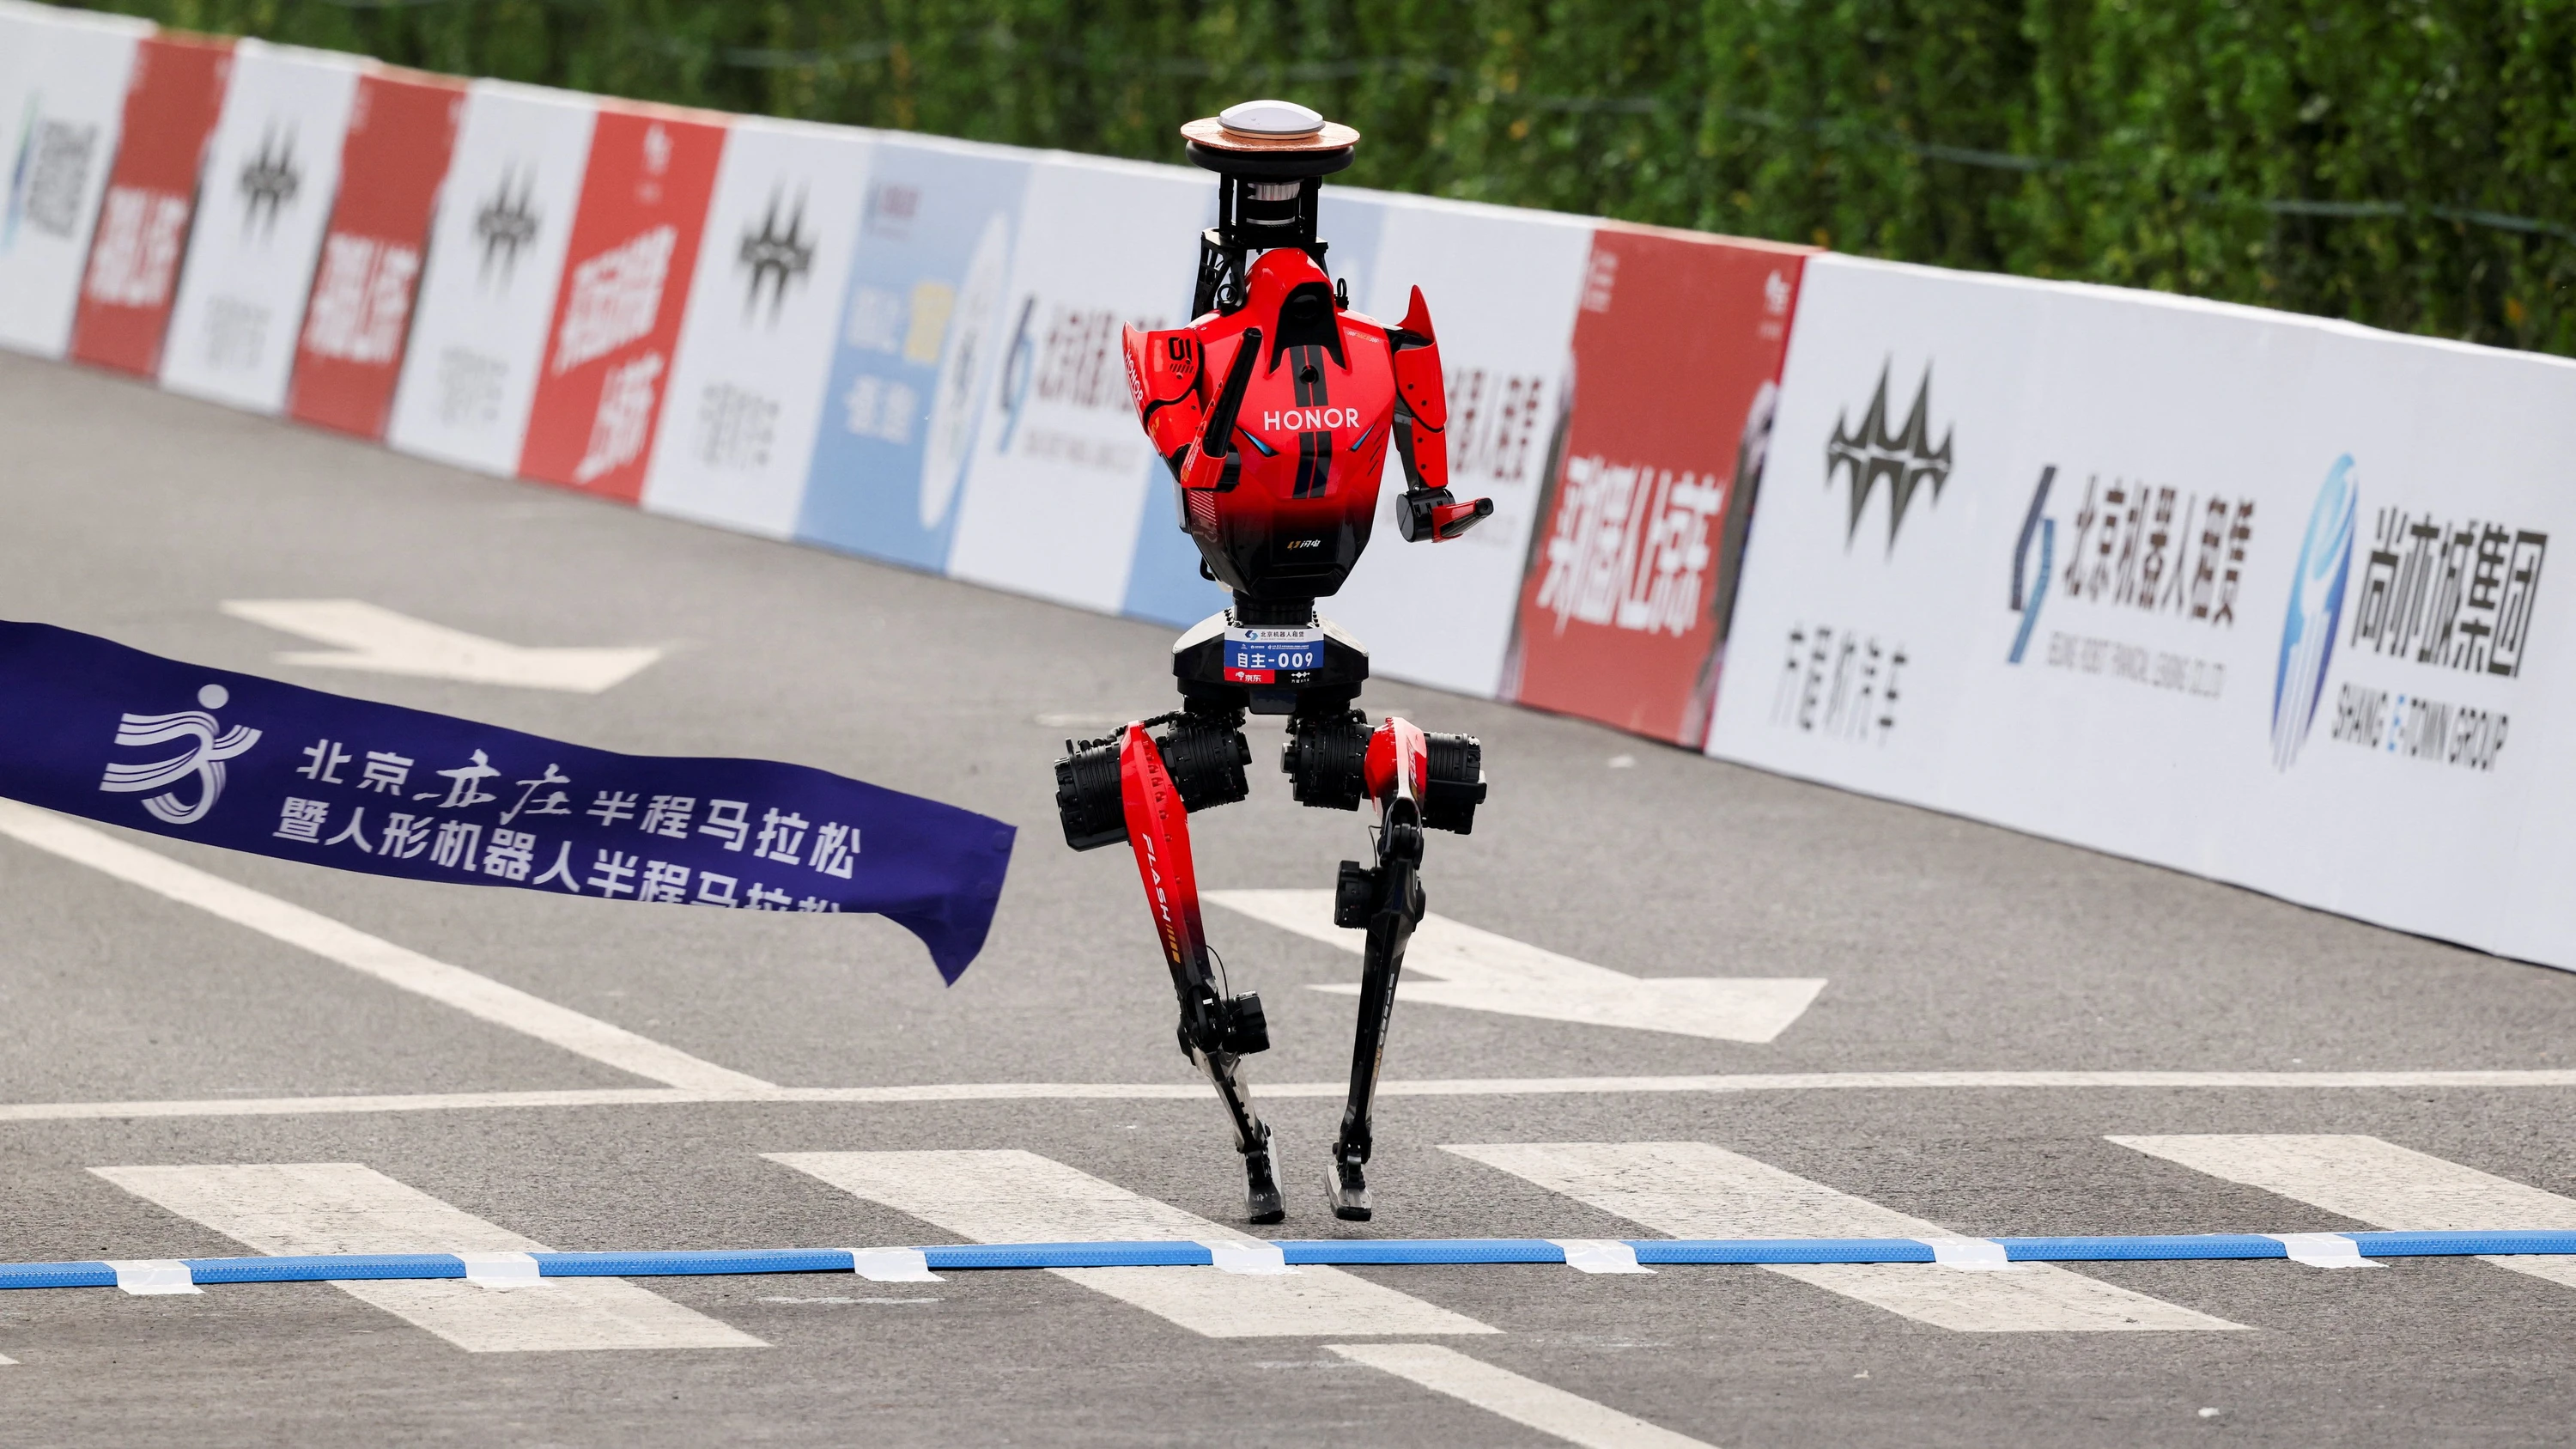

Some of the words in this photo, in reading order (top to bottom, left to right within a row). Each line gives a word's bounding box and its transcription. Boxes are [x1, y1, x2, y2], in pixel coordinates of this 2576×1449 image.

[1125, 349, 1144, 404] HONOR
[1168, 337, 1193, 362] 01
[1264, 408, 1359, 430] HONOR
[2350, 505, 2549, 679] 尚亦城集团
[1237, 652, 1314, 668] 自主-009
[2448, 706, 2509, 771] GROUP
[272, 796, 841, 912] 暨人形机器人半程马拉
[1141, 832, 1171, 922] FLASH
